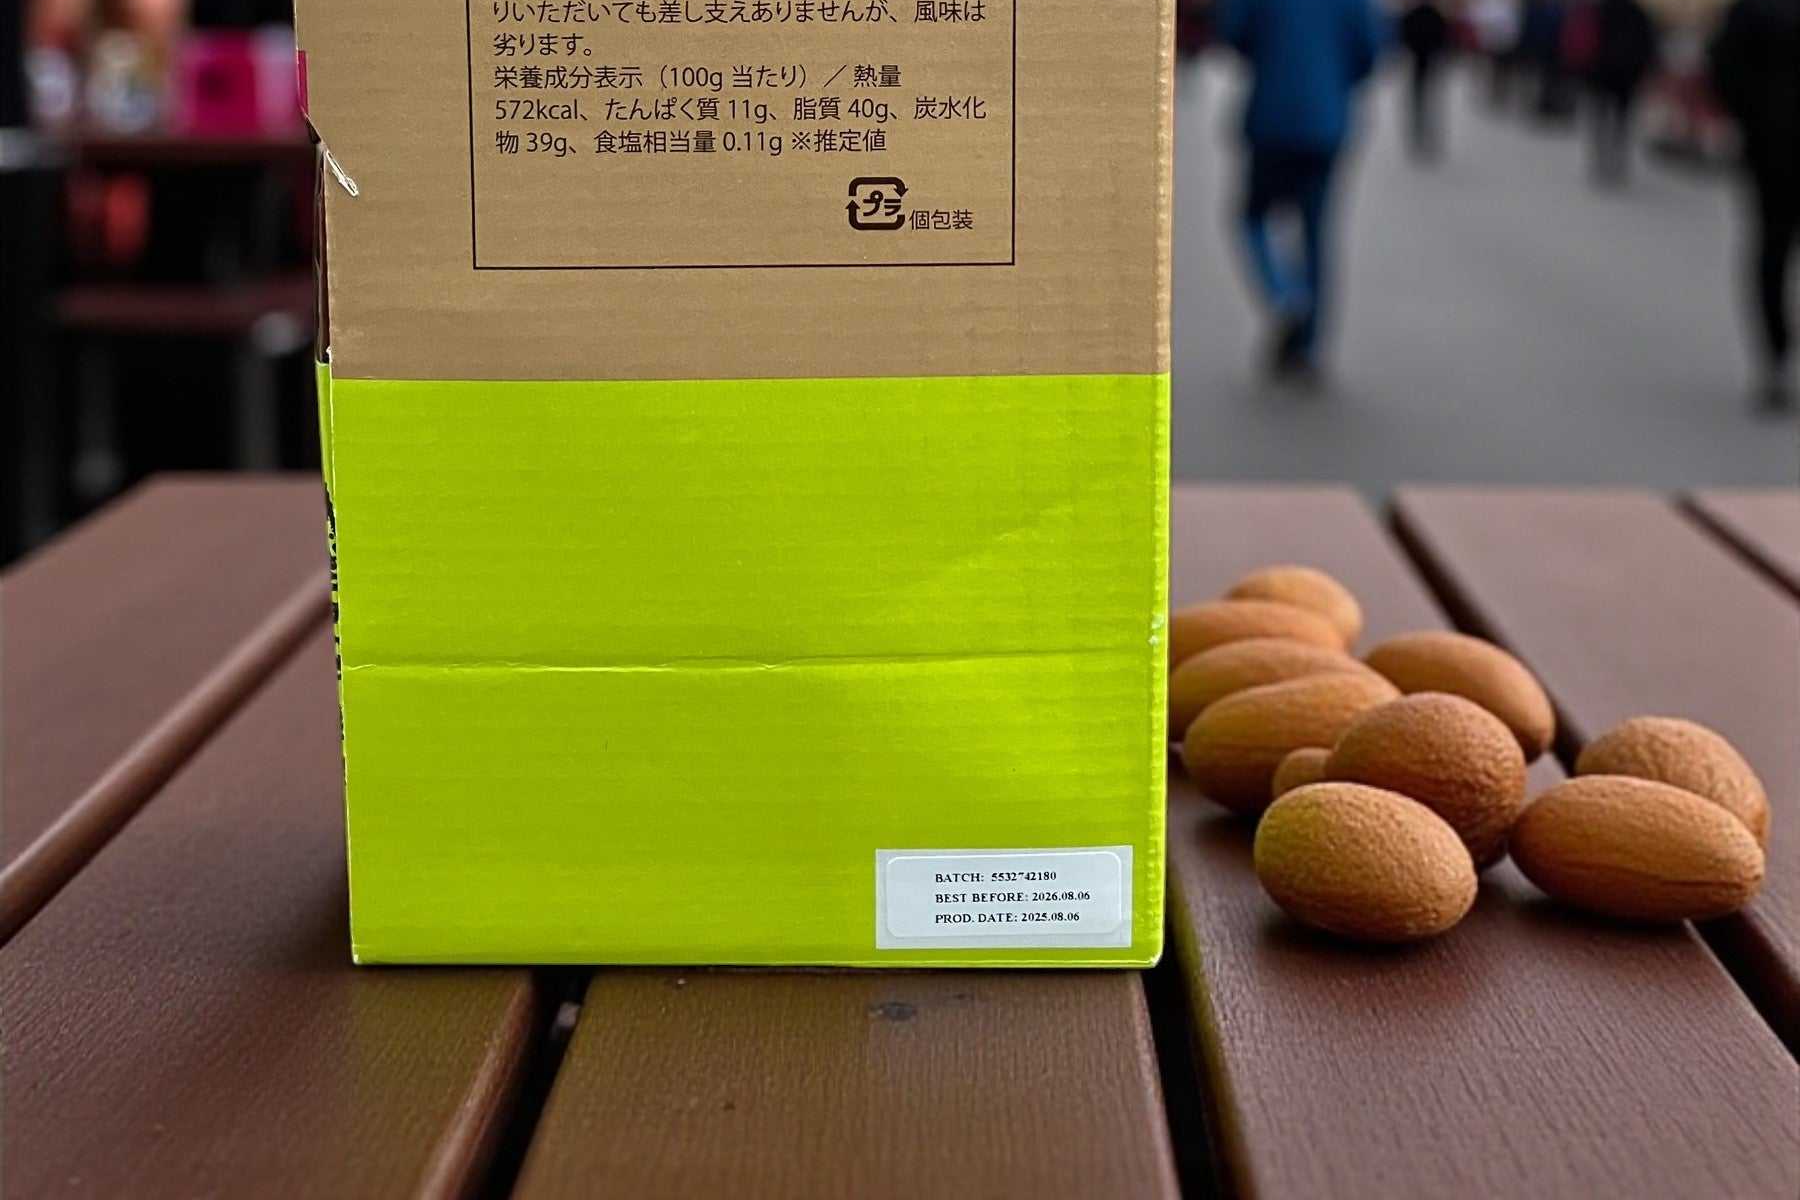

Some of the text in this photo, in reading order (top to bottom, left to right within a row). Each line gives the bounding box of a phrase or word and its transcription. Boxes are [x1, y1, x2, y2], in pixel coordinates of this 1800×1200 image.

[493, 32, 592, 57] 劣ります。
[909, 208, 974, 230] 個包装
[935, 872, 984, 884] BATCH:
[935, 890, 1091, 904] BEST BEFORE: 2026.08.06
[935, 911, 1080, 924] PROD. DATE: 2025.08.06
